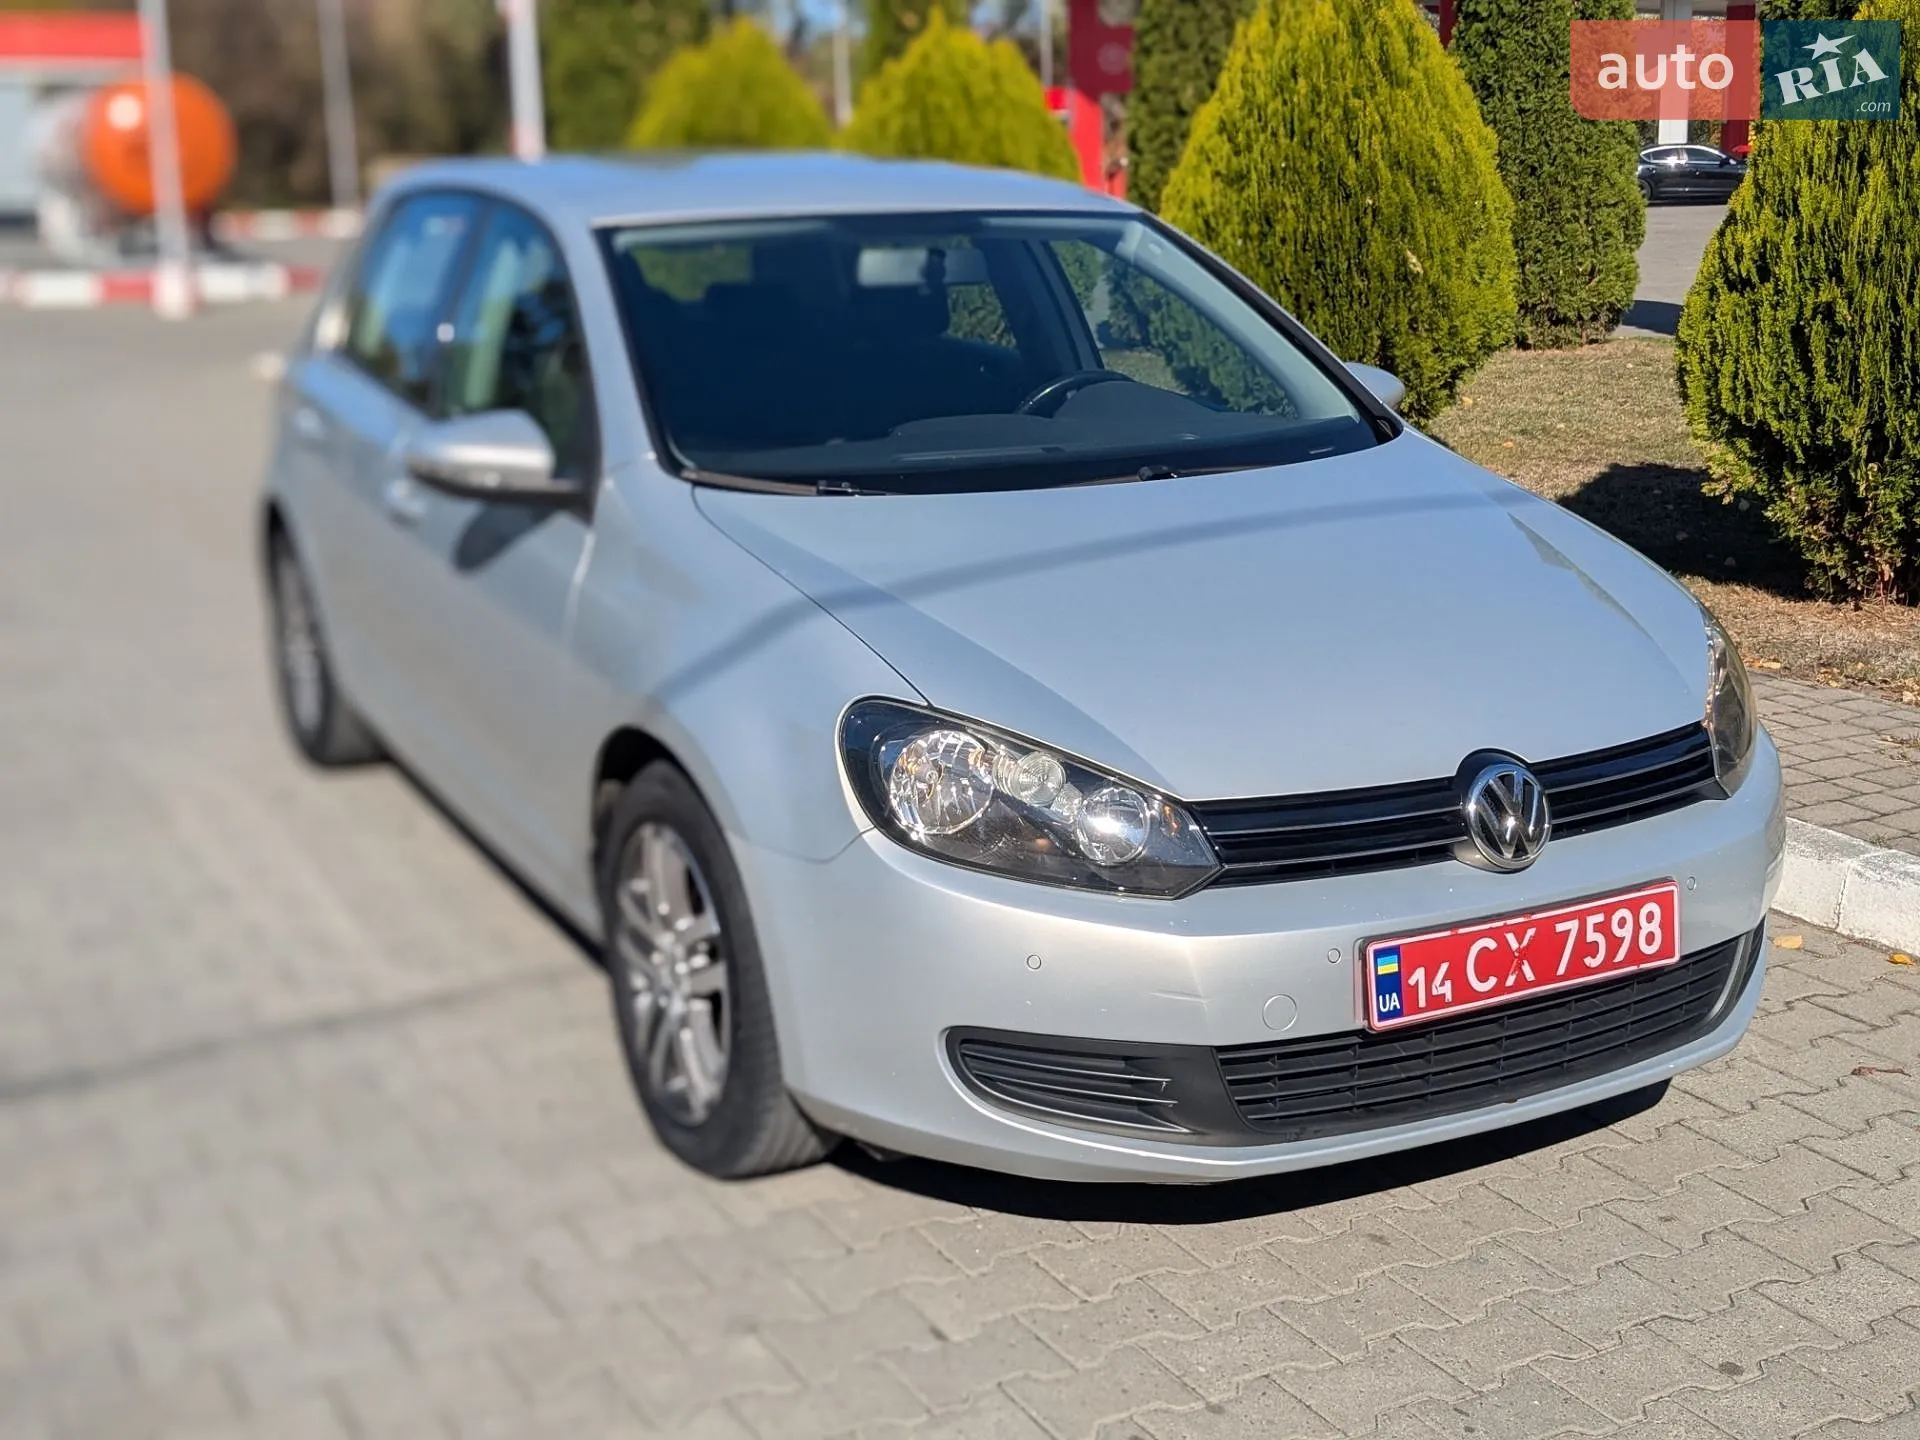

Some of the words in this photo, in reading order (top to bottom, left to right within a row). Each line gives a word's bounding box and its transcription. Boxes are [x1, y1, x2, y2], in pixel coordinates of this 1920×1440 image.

[1408, 962, 1453, 1008] 14
[1466, 928, 1536, 992] CX
[1555, 902, 1662, 976] 7598
[1379, 993, 1400, 1013] UA
